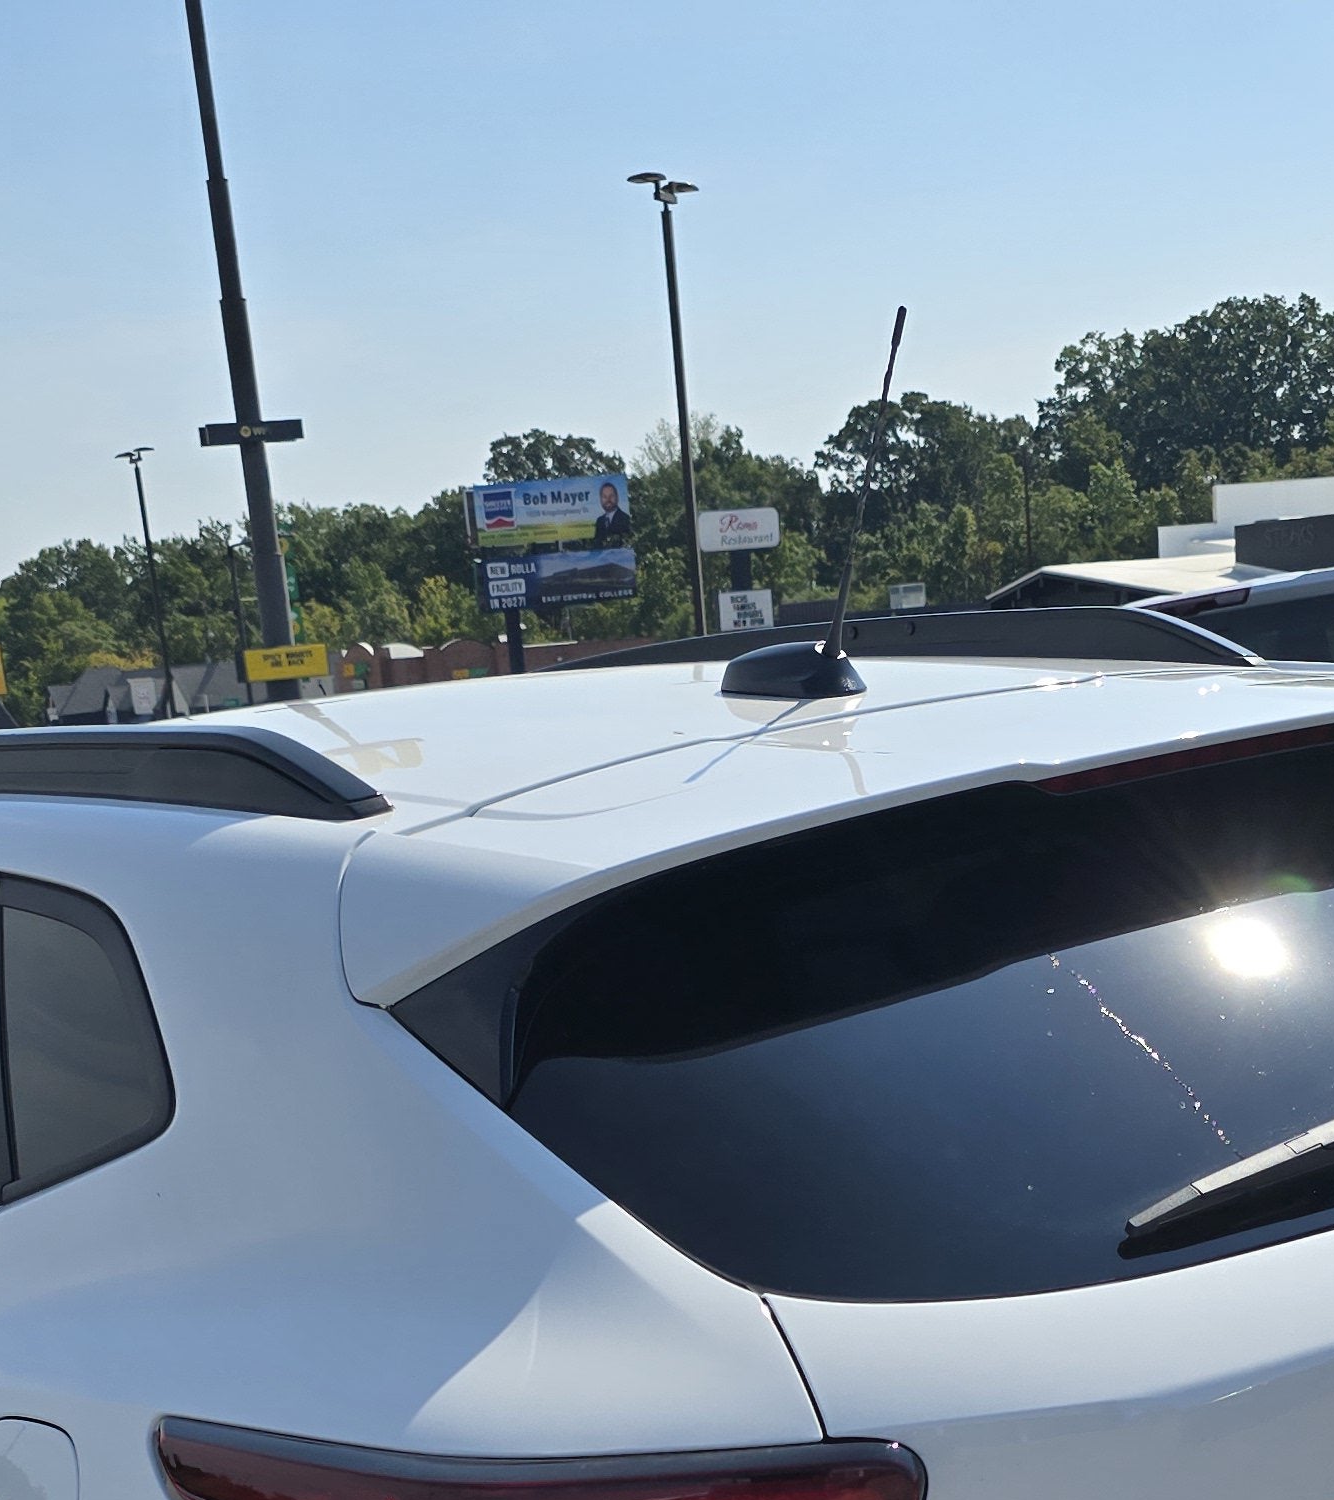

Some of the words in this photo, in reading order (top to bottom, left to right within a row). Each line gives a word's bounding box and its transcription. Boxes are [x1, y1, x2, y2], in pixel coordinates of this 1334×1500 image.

[522, 492, 548, 506] Bob
[551, 490, 591, 507] Mayer
[720, 531, 773, 547] Restaurant
[510, 562, 536, 575] ROLLA
